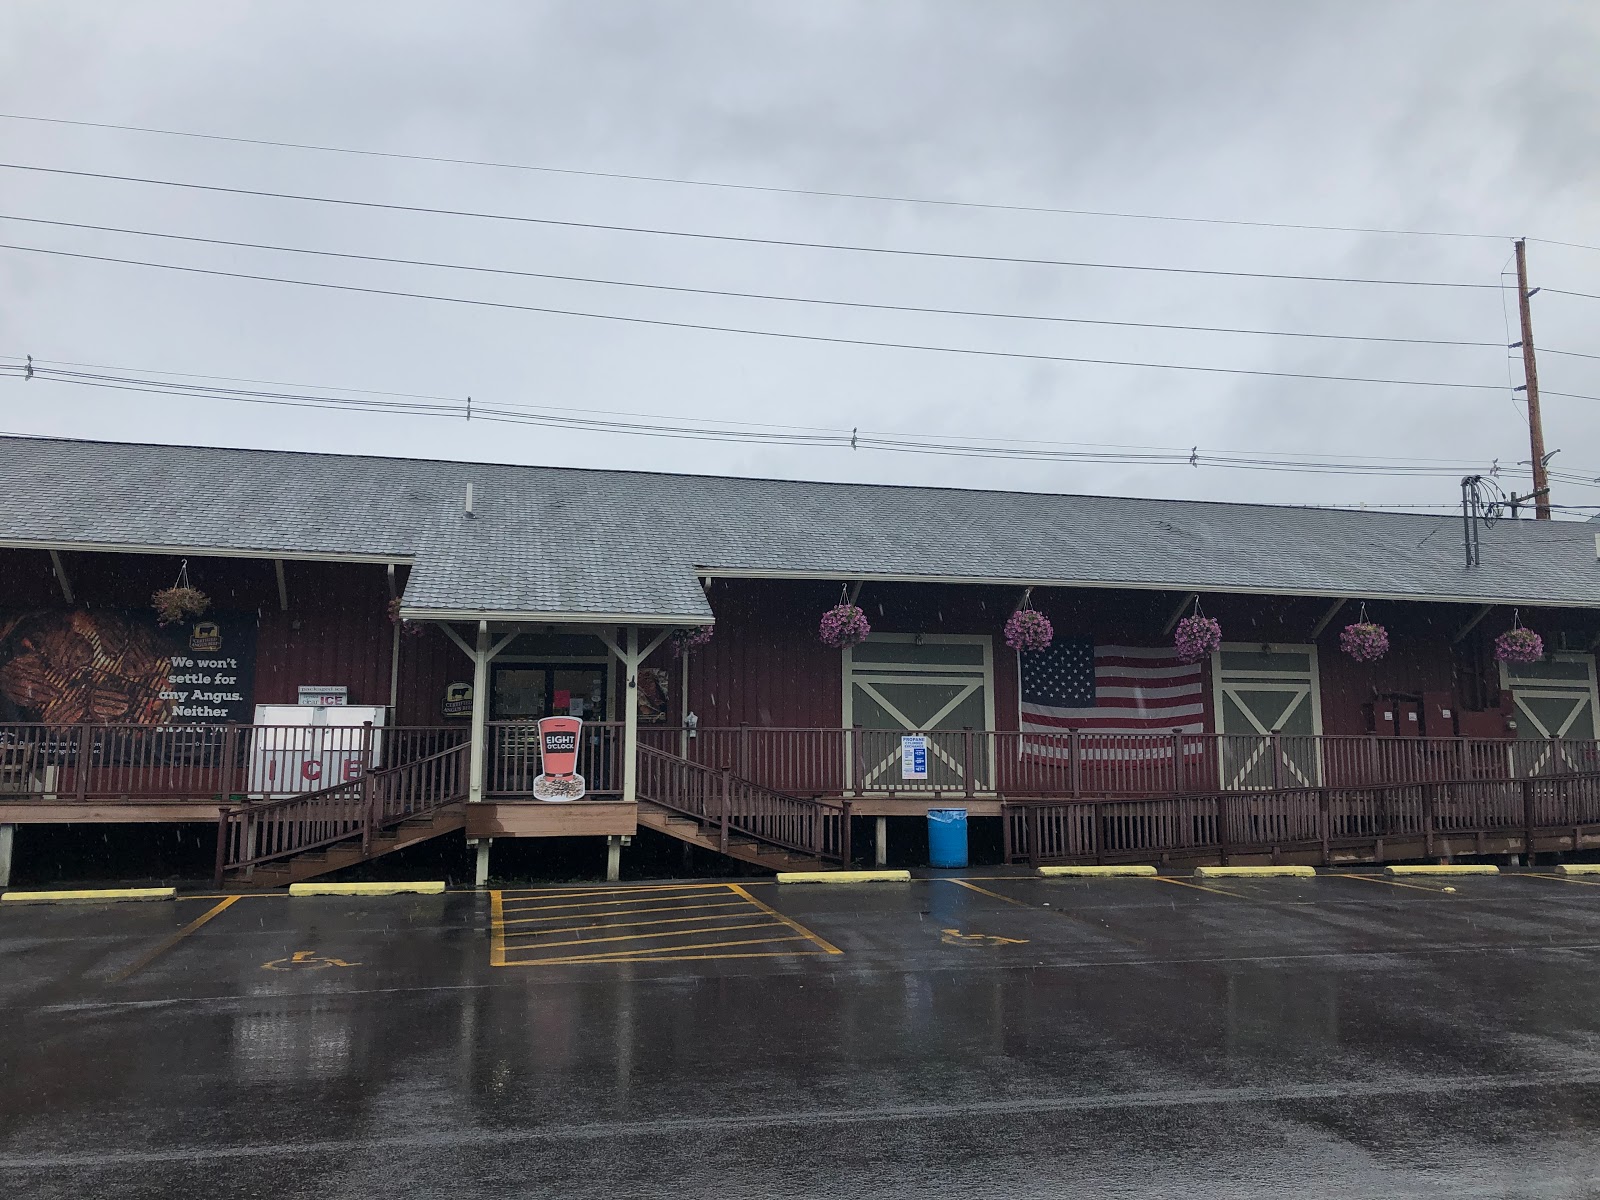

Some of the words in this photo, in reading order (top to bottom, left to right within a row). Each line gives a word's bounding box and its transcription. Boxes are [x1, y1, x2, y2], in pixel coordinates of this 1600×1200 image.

[171, 656, 194, 668] We
[197, 657, 237, 668] won't
[168, 673, 211, 684] settle
[214, 673, 236, 685] for
[158, 690, 189, 702] any
[191, 689, 243, 703] Angus.
[320, 696, 343, 705] ICE
[171, 705, 228, 717] Neither
[546, 735, 575, 744] EIGHT
